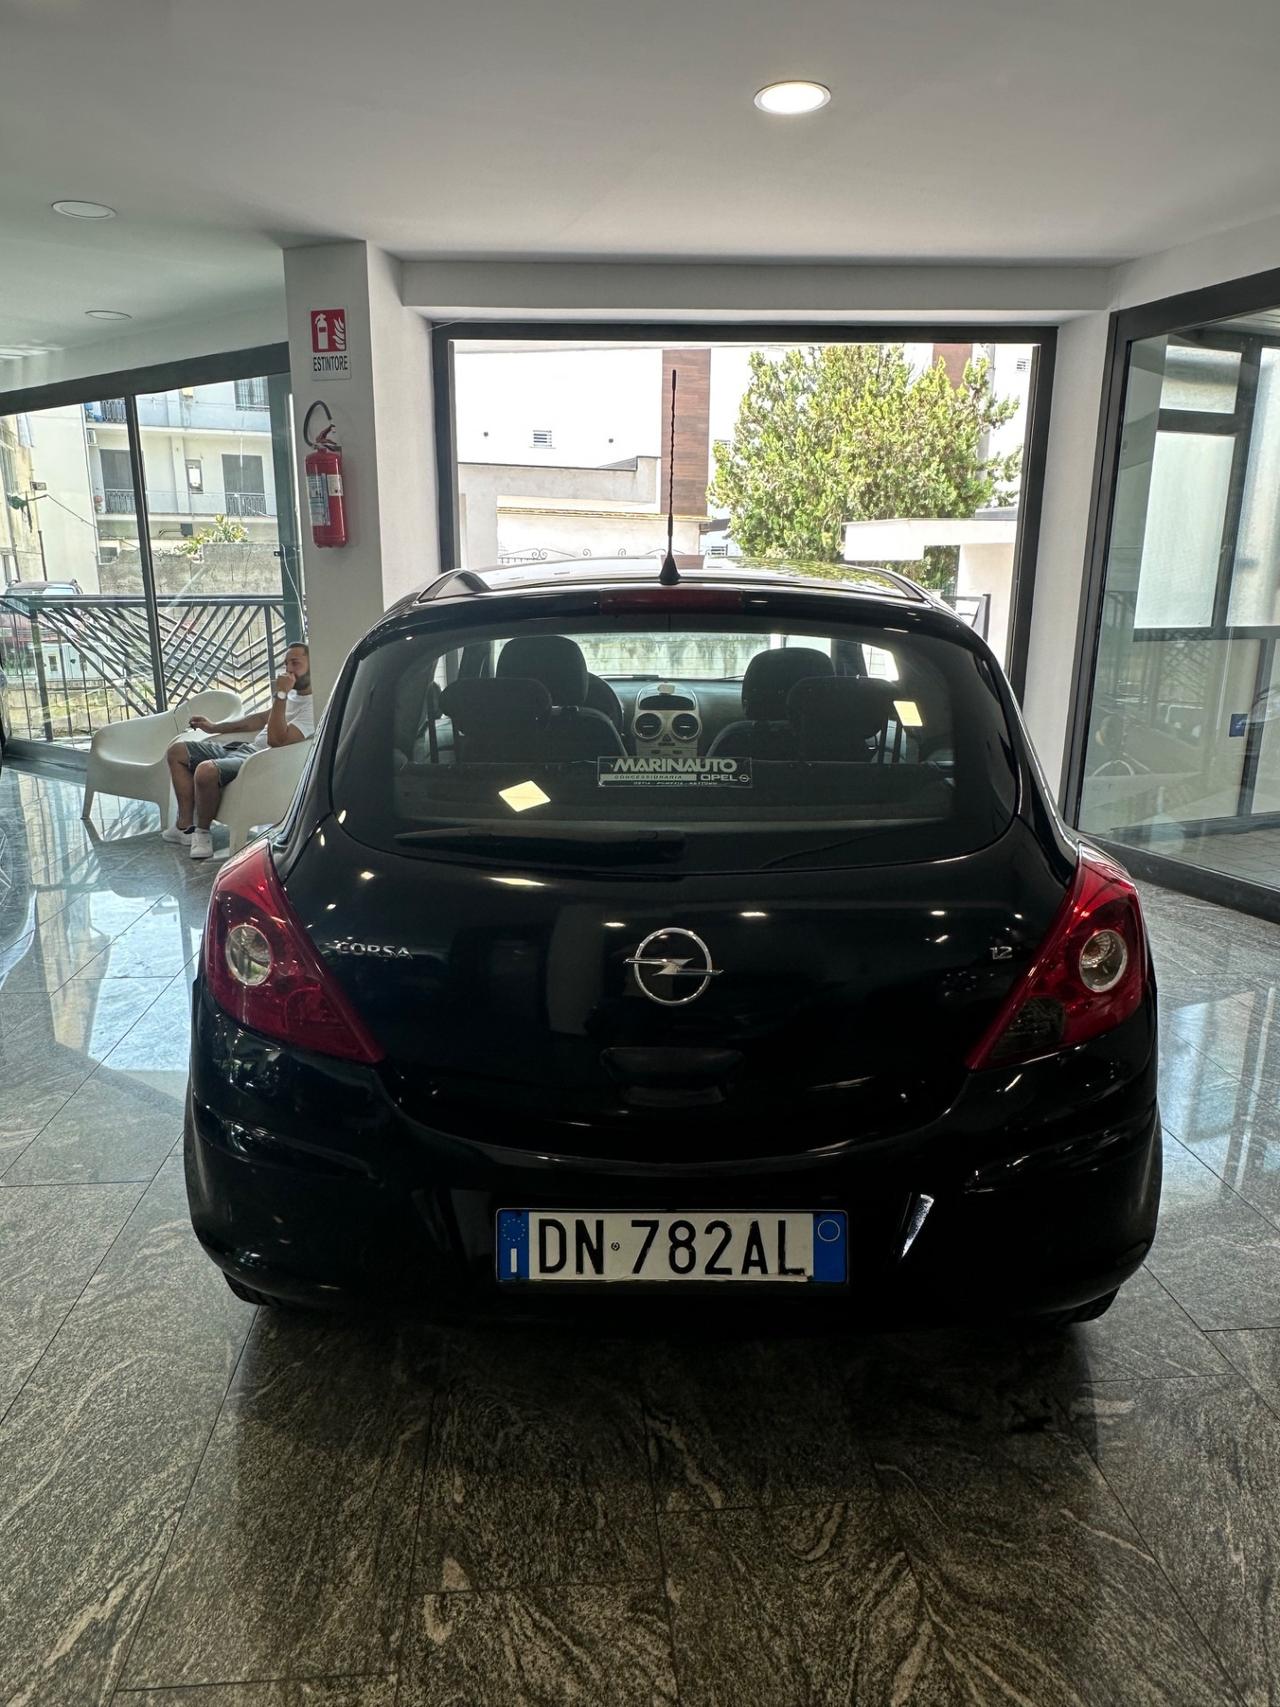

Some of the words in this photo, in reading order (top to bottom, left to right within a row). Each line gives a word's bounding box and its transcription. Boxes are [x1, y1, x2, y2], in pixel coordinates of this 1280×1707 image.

[313, 356, 348, 371] ESTINTORE
[613, 758, 737, 773] MARINAUTO
[701, 774, 738, 782] OPEL
[336, 942, 413, 959] CORSA
